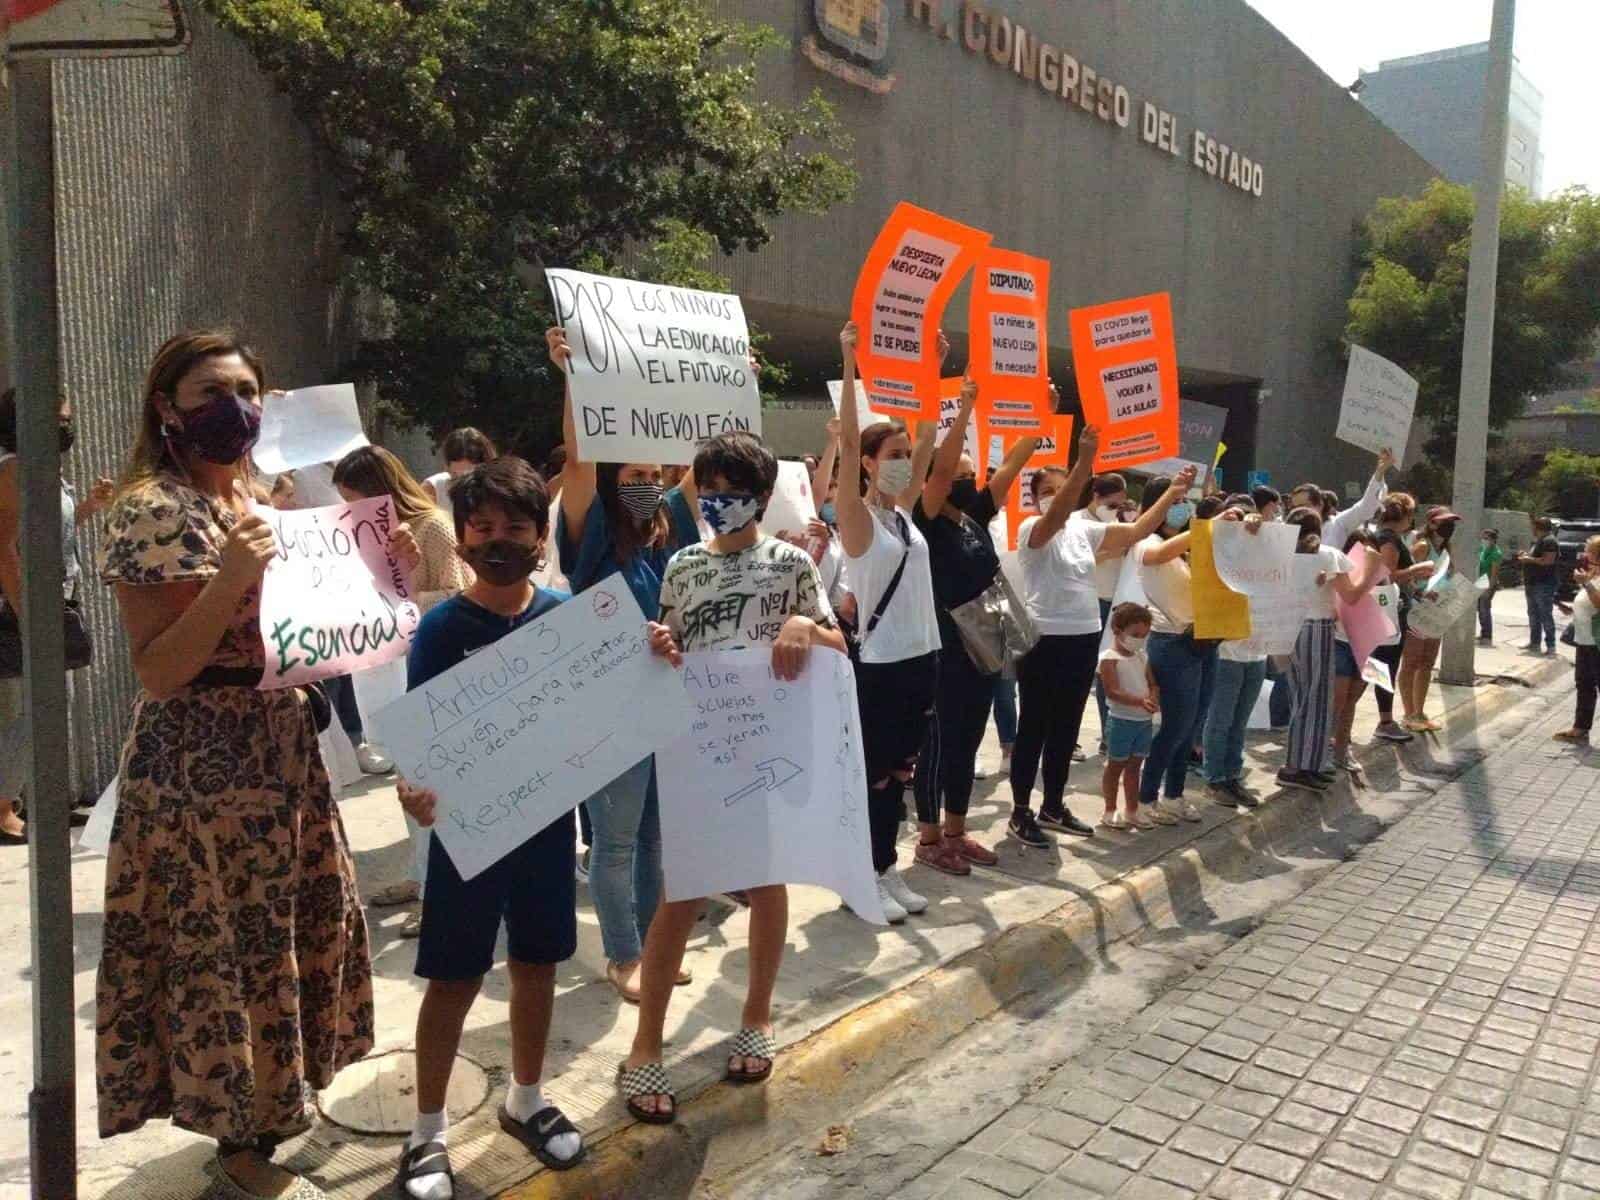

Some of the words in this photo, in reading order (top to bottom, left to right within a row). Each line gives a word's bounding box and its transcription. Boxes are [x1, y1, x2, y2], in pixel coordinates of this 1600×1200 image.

[961, 4, 1130, 128] CONGRESO
[1142, 102, 1180, 157] DEL
[1193, 130, 1264, 197] ESTADO
[888, 259, 918, 276] NUEVO
[551, 275, 645, 380] POR
[626, 285, 667, 314] LOS
[993, 314, 1005, 326] La
[1103, 317, 1129, 330] COVID
[884, 335, 894, 349] SE
[993, 336, 1018, 349] NUEVO
[646, 359, 675, 384] EL
[678, 359, 746, 388] FUTURO
[1116, 383, 1145, 399] VOLVER
[1146, 383, 1153, 392] A
[583, 405, 617, 437] DE
[1116, 405, 1132, 417] LAS
[693, 568, 719, 587] TOP
[746, 559, 795, 574] EXPRESS
[682, 592, 756, 640] STREET
[270, 591, 405, 676] Esencial
[527, 622, 562, 656] 3
[568, 630, 628, 677] respetar
[683, 663, 740, 689] Abre
[455, 756, 477, 780] mi
